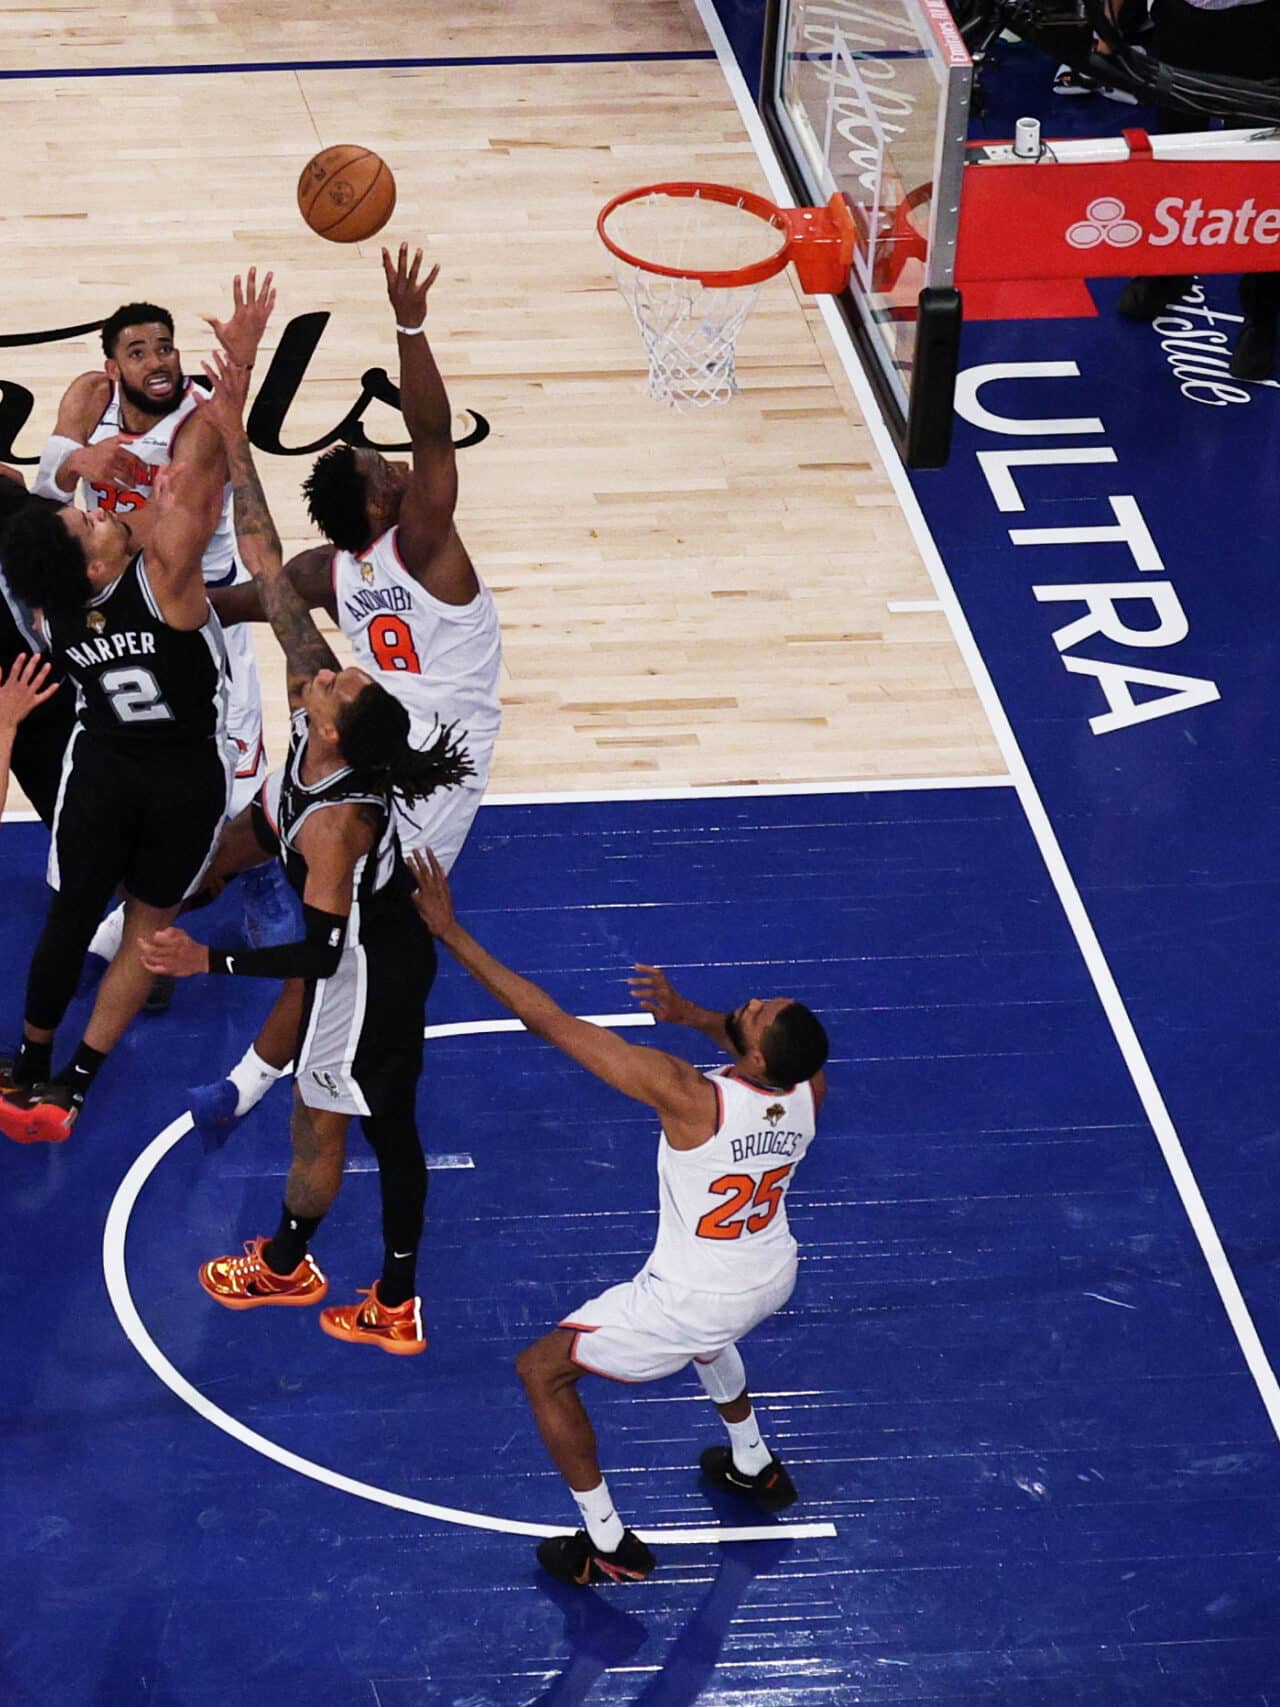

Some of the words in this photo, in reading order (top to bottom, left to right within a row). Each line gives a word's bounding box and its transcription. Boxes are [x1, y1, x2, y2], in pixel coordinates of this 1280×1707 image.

[1148, 197, 1280, 246] State
[953, 361, 1221, 736] ULTRA
[65, 631, 156, 668] HARPER
[368, 614, 422, 675] 8
[100, 666, 176, 723] 2
[730, 1130, 802, 1162] BRIDGES
[695, 1161, 797, 1241] 25
